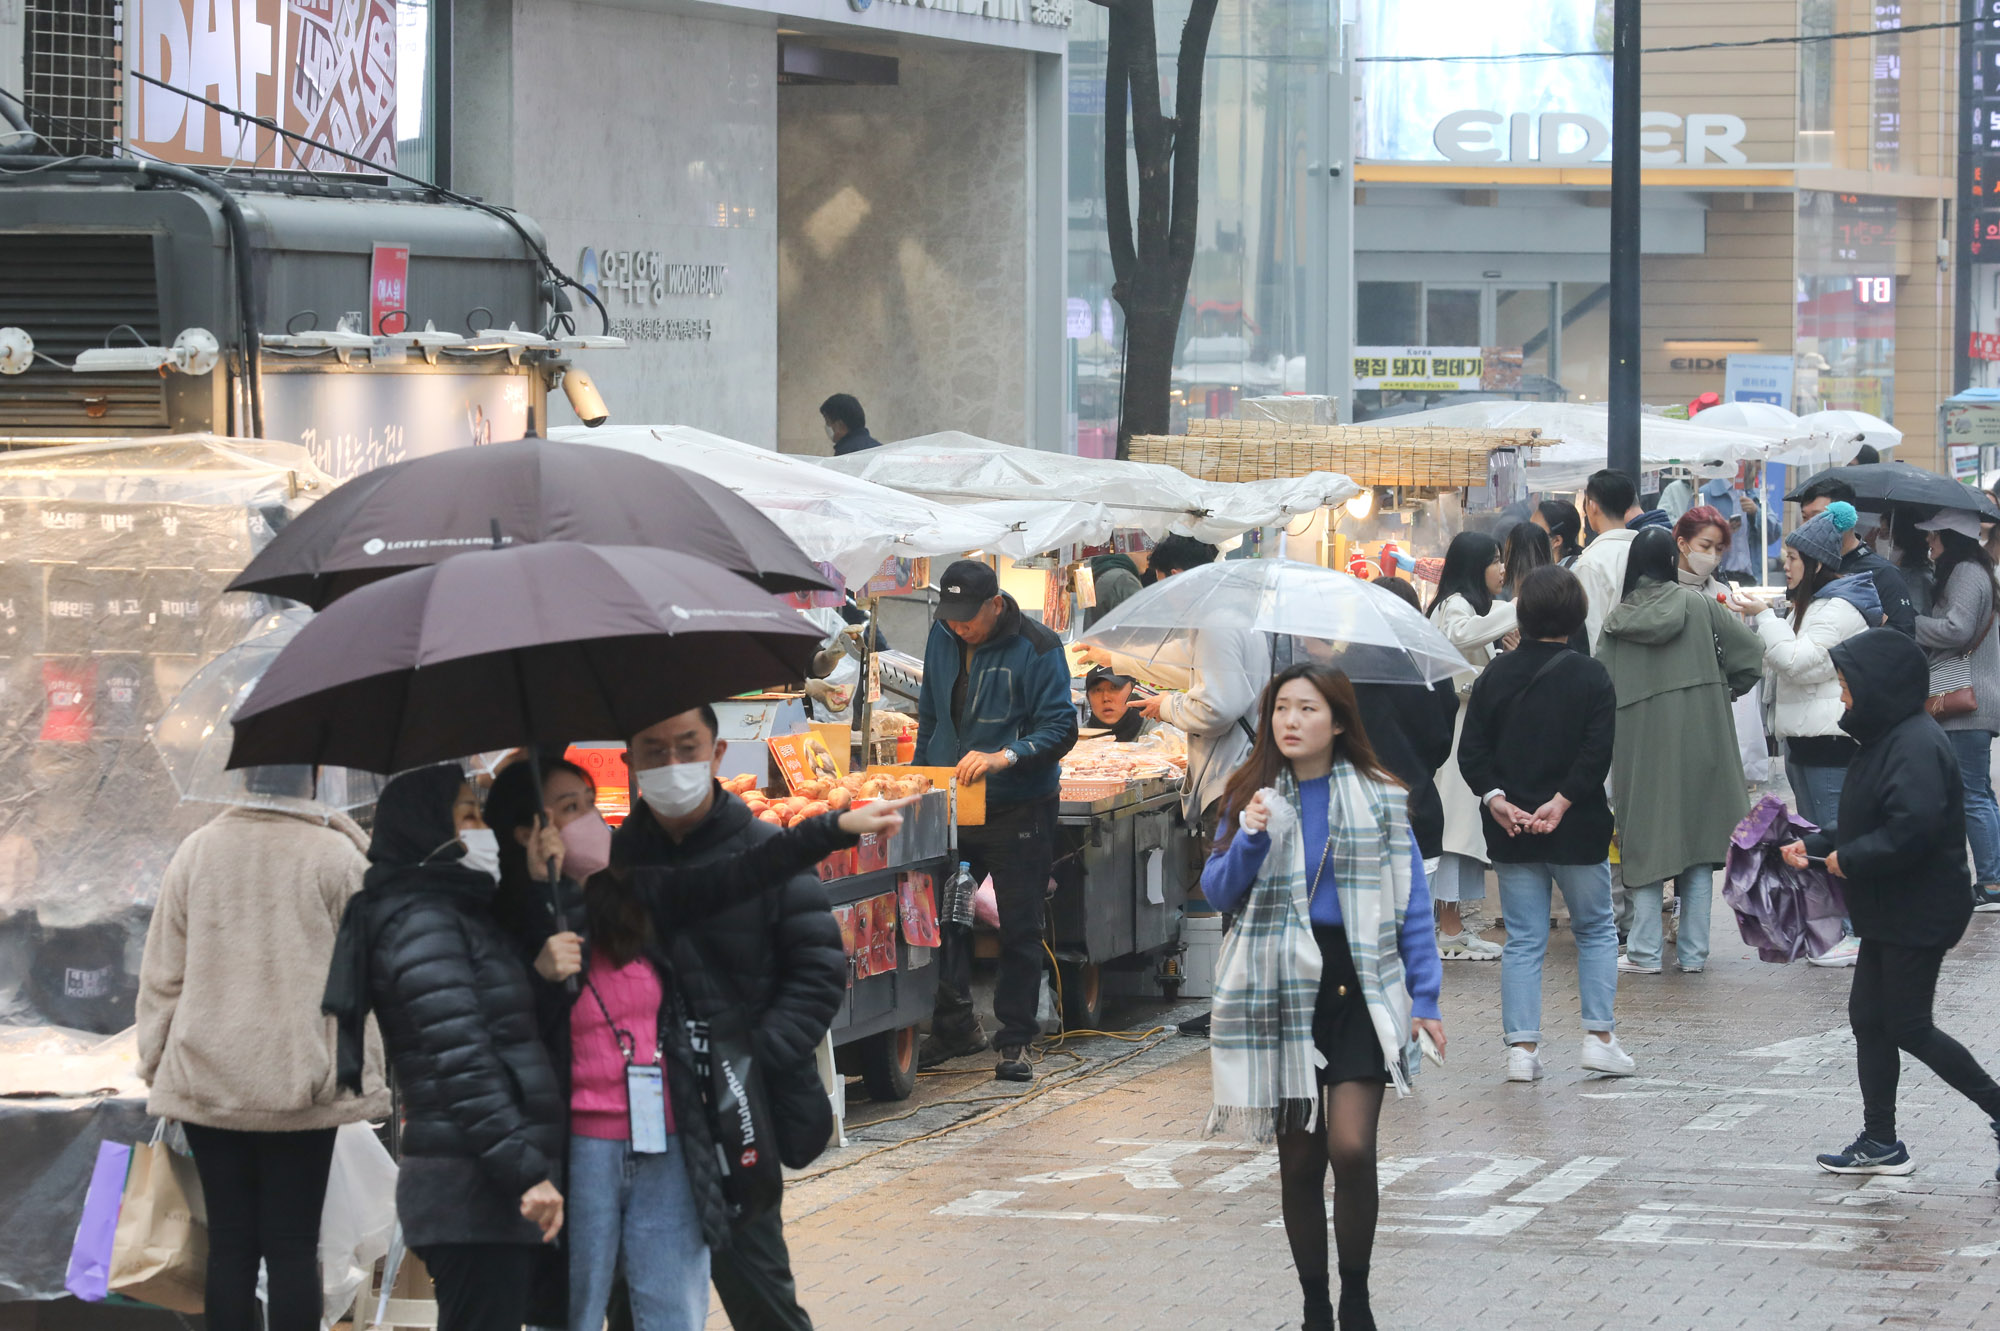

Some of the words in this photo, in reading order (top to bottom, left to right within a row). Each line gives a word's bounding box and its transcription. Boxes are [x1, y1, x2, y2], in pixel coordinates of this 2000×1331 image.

[1433, 110, 1747, 165] EIDER
[602, 249, 665, 304] 우리은행
[667, 264, 699, 294] WOORI
[700, 265, 725, 295] BANK
[1407, 348, 1432, 356] Korea
[1354, 358, 1387, 377] 벌집
[1392, 358, 1426, 377] 돼지
[1670, 358, 1727, 370] EIDE
[387, 540, 428, 550] LOTTE
